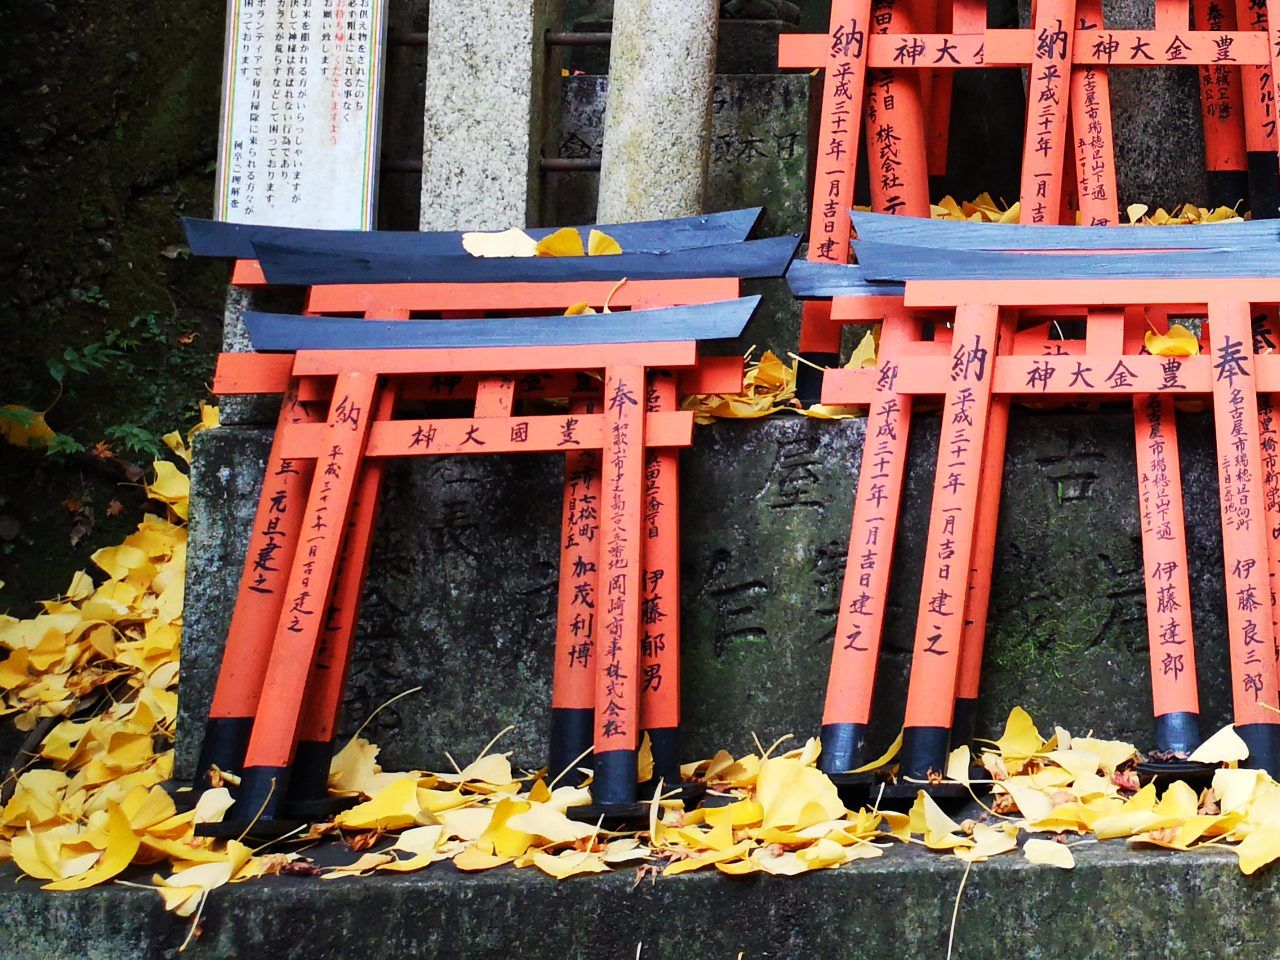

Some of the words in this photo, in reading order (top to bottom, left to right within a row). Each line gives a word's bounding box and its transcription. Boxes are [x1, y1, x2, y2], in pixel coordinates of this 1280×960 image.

[831, 18, 864, 58] 納
[1036, 19, 1069, 59] 納
[876, 124, 905, 190] 株式会社
[950, 335, 987, 385] 納
[330, 395, 361, 432] 納
[608, 379, 638, 421] 奉
[1214, 336, 1250, 389] 奉
[1232, 558, 1265, 703] 伊藤良三郎
[567, 555, 597, 669] 加茂利博
[1152, 560, 1188, 682] 伊藤達郎
